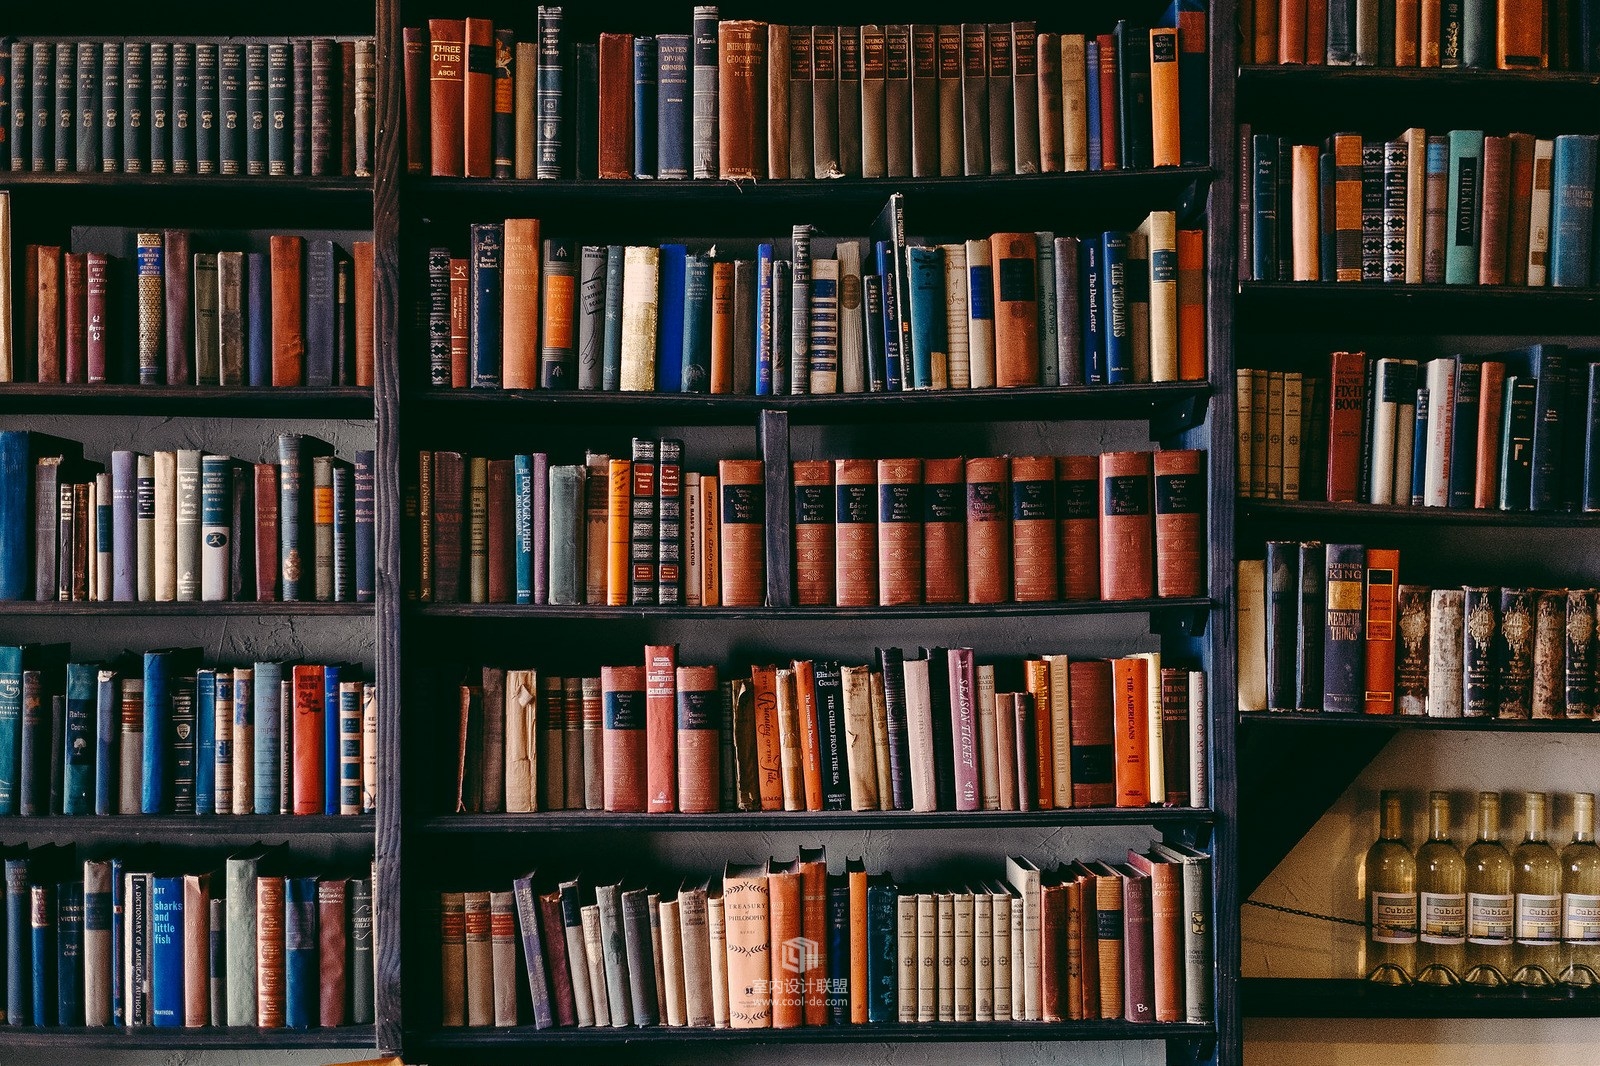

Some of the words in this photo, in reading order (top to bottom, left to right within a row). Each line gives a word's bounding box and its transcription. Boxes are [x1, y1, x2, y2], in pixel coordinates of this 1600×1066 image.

[696, 37, 716, 45] Plutarch
[726, 42, 762, 51] INTERNATIONAL
[432, 45, 461, 53] THREE
[432, 54, 461, 63] CITIES
[726, 54, 762, 65] GEOGRAPHY
[437, 69, 456, 77] ASCH
[1459, 168, 1473, 233] CHEKHOV
[897, 219, 905, 247] PRIMATES
[1089, 272, 1097, 288] The
[1111, 263, 1123, 285] THE
[761, 287, 771, 325] MURDER
[887, 296, 894, 305] Up
[1112, 286, 1125, 338] TROJANS
[1090, 309, 1098, 333] Letter
[760, 330, 770, 362] PALACE
[1335, 398, 1363, 410] BOOK
[422, 455, 431, 482] Duchess
[421, 489, 431, 516] Nothing
[849, 502, 868, 510] Edgar
[522, 476, 532, 553] PORNOGRAPHER
[1023, 509, 1045, 517] Dumas
[1067, 507, 1090, 515] Kipling
[1328, 569, 1361, 579] KING
[1327, 611, 1361, 626] NEEDFUL
[1330, 626, 1358, 641] THINGS
[1037, 665, 1047, 686] Face
[818, 679, 840, 688] Goudge
[959, 678, 970, 722] SEASON
[1038, 686, 1047, 711] Value
[757, 691, 777, 737] Running
[1127, 694, 1136, 740] AMERICANS
[1197, 723, 1204, 737] OF
[829, 734, 837, 755] FROM
[961, 724, 973, 769] TICKET
[1197, 740, 1204, 755] MY
[760, 754, 781, 787] Tide
[134, 891, 142, 934] DICTIONARY
[154, 901, 183, 911] sharks
[154, 912, 170, 922] and
[154, 923, 175, 933] little
[134, 936, 142, 946] OF
[154, 934, 171, 944] fish
[134, 947, 142, 983] AMERICAN
[134, 985, 142, 1018] AUTHORS
